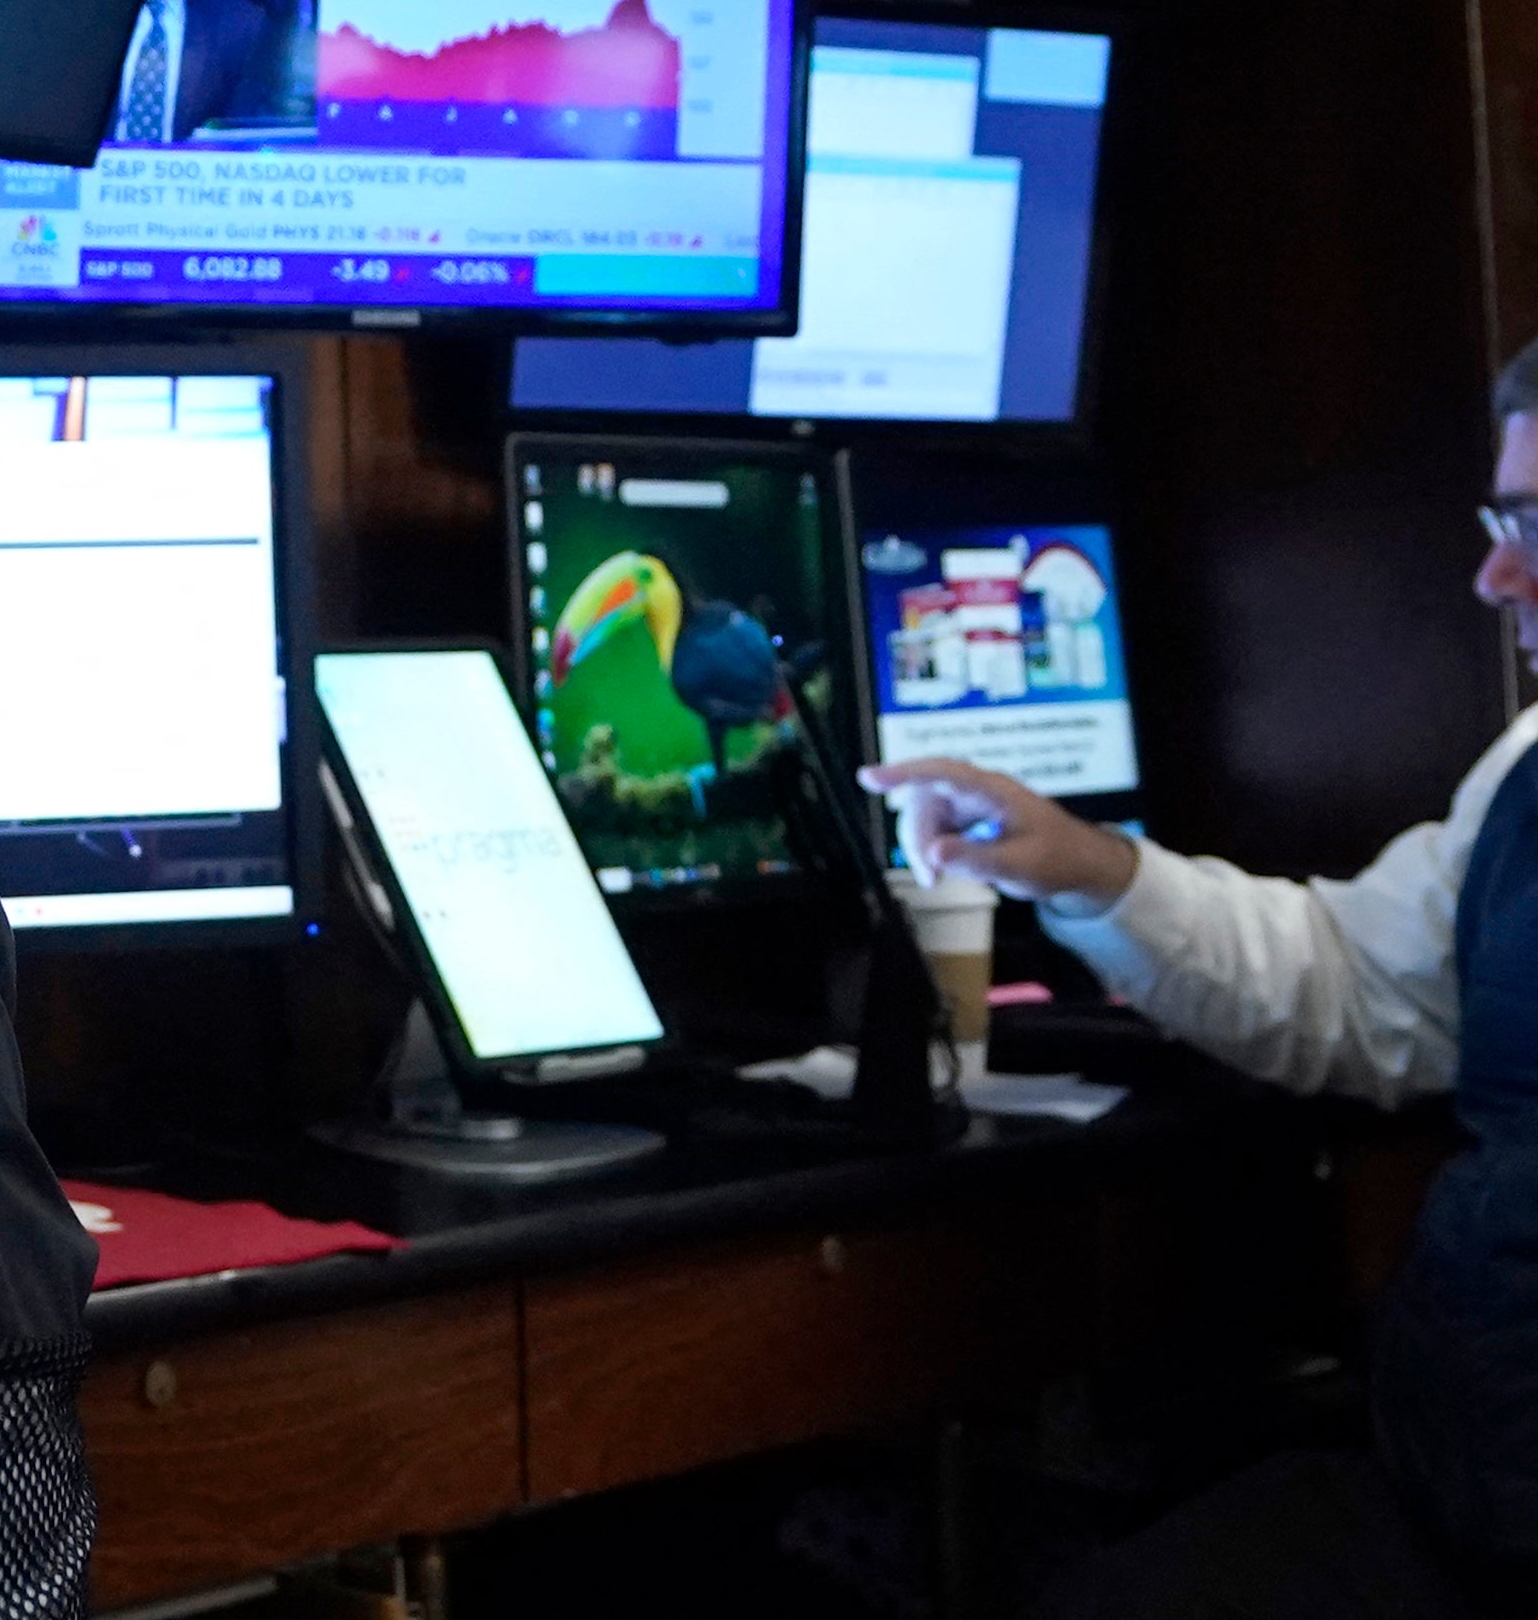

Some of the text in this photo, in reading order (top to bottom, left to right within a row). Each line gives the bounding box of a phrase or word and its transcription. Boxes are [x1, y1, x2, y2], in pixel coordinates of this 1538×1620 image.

[100, 158, 148, 180] S&P
[215, 162, 318, 183] NASDAQ
[323, 166, 411, 185] LOWER
[420, 167, 466, 185] FOR
[99, 185, 354, 210] FIRST TIME IN 4 DAYS
[83, 220, 140, 240] Sprott
[146, 221, 219, 241] Physical
[225, 223, 268, 240] Gold
[273, 224, 320, 241] PHYS
[331, 258, 391, 282] -3.49
[431, 260, 512, 285] -0.06%
